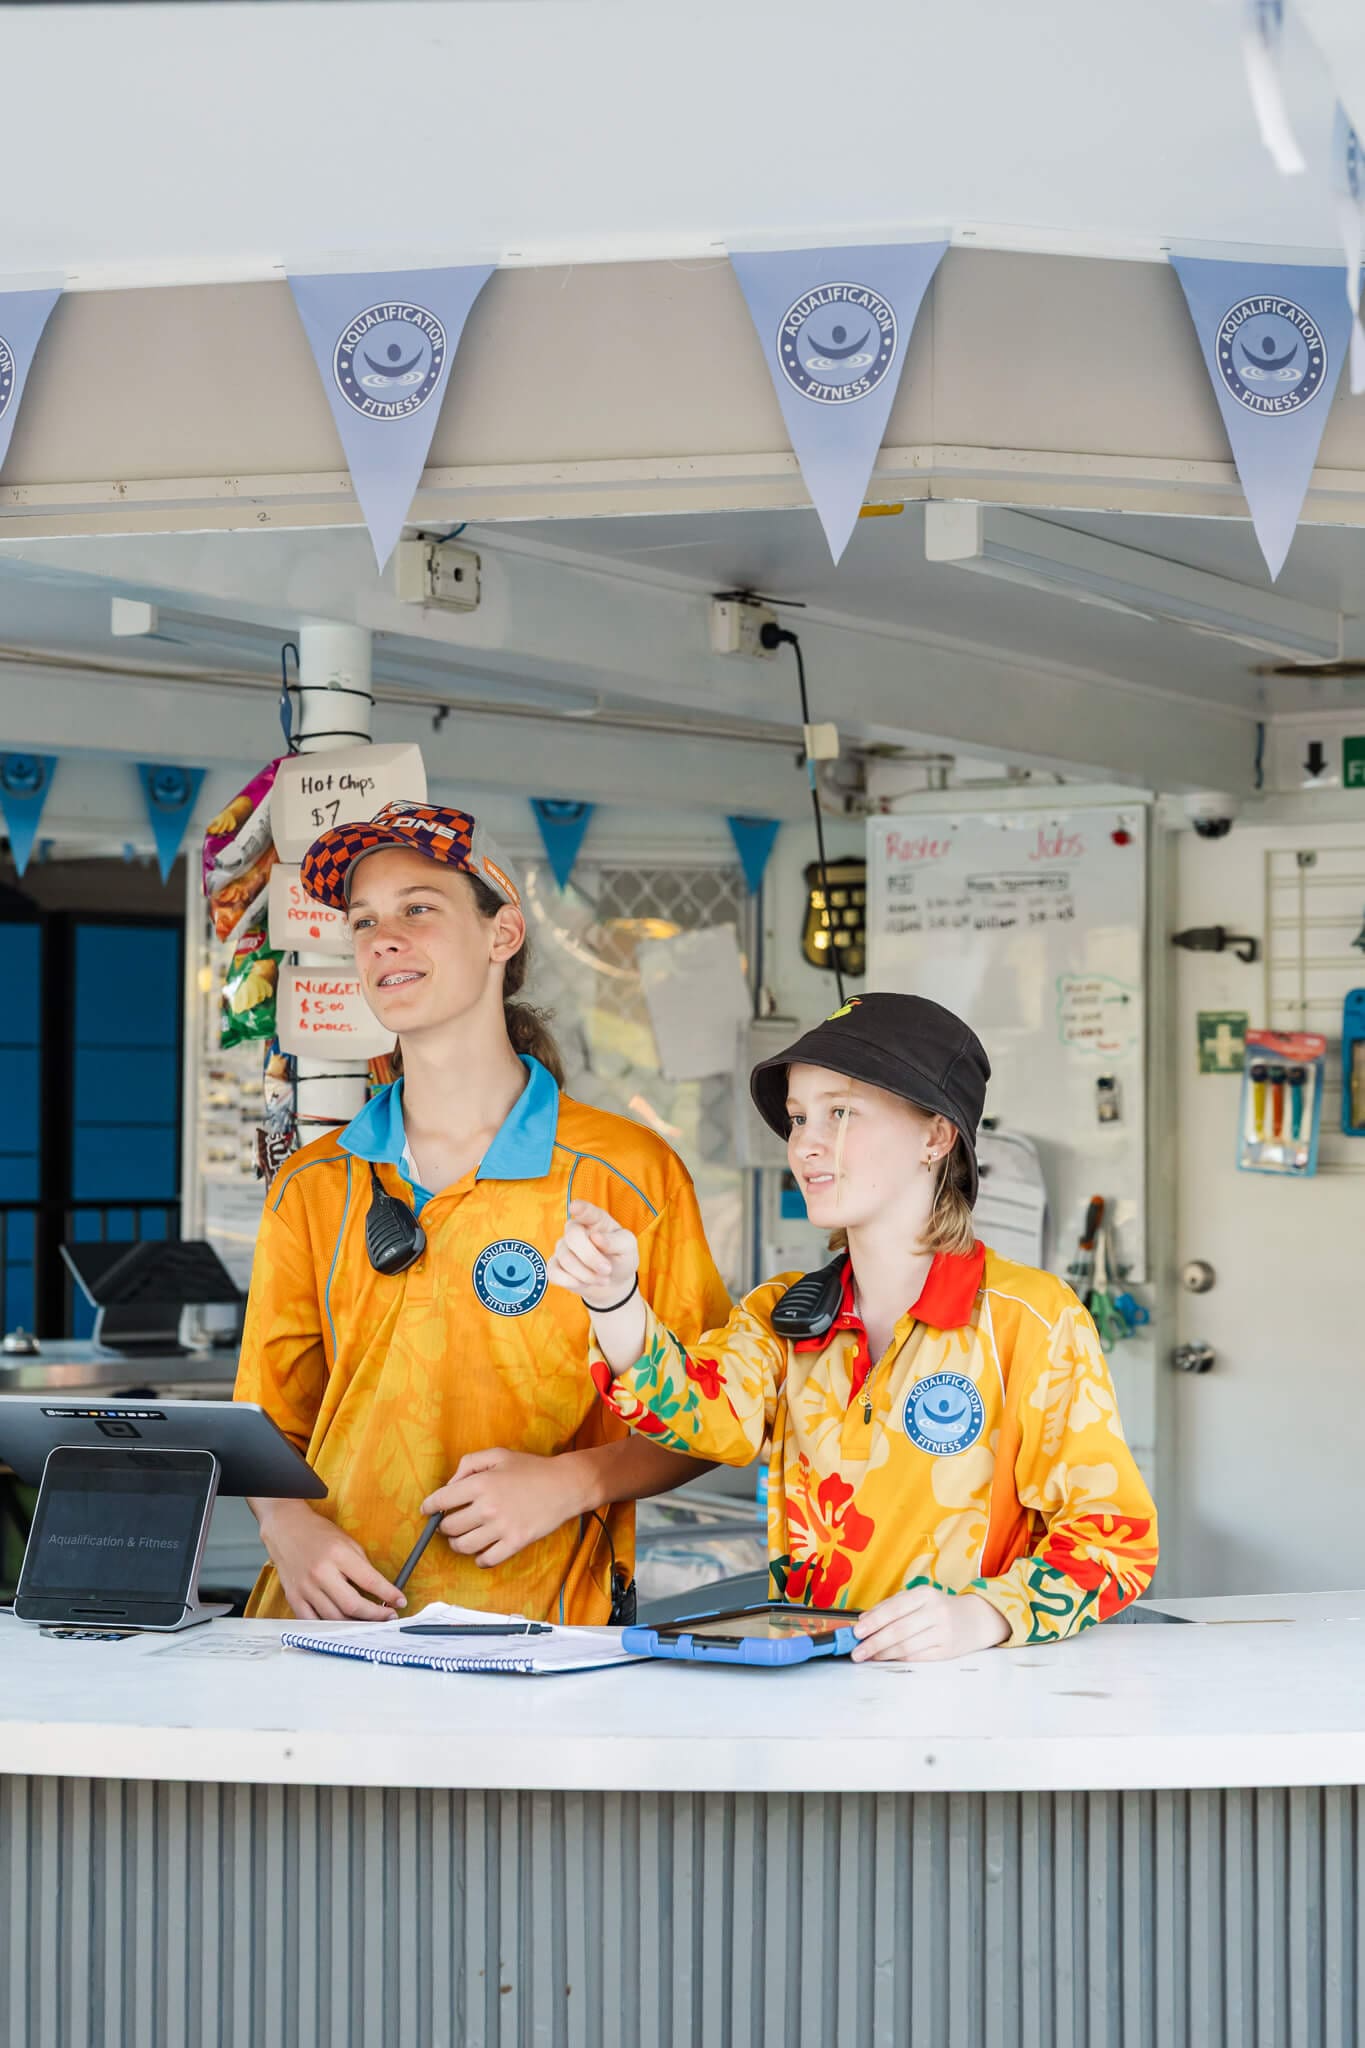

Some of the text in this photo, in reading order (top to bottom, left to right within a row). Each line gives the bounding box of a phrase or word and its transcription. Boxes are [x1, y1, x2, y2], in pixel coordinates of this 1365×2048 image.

[784, 287, 893, 337] AQUALIFICATION
[341, 306, 443, 354] AQUALIFICATION
[1221, 300, 1321, 350] AQUALIFICATION
[805, 376, 871, 400] FITNESS
[1242, 389, 1300, 411] FITNESS
[361, 393, 421, 416] FITNESS
[301, 773, 376, 798] Hot Chips
[311, 800, 341, 827] $7
[480, 1242, 545, 1280] AQUALIFICATION
[485, 1295, 524, 1313] FITNESS
[910, 1375, 982, 1413] AQUALIFICATION
[916, 1434, 962, 1453] FITNESS
[48, 1534, 180, 1549] Aqualification & Fitness
